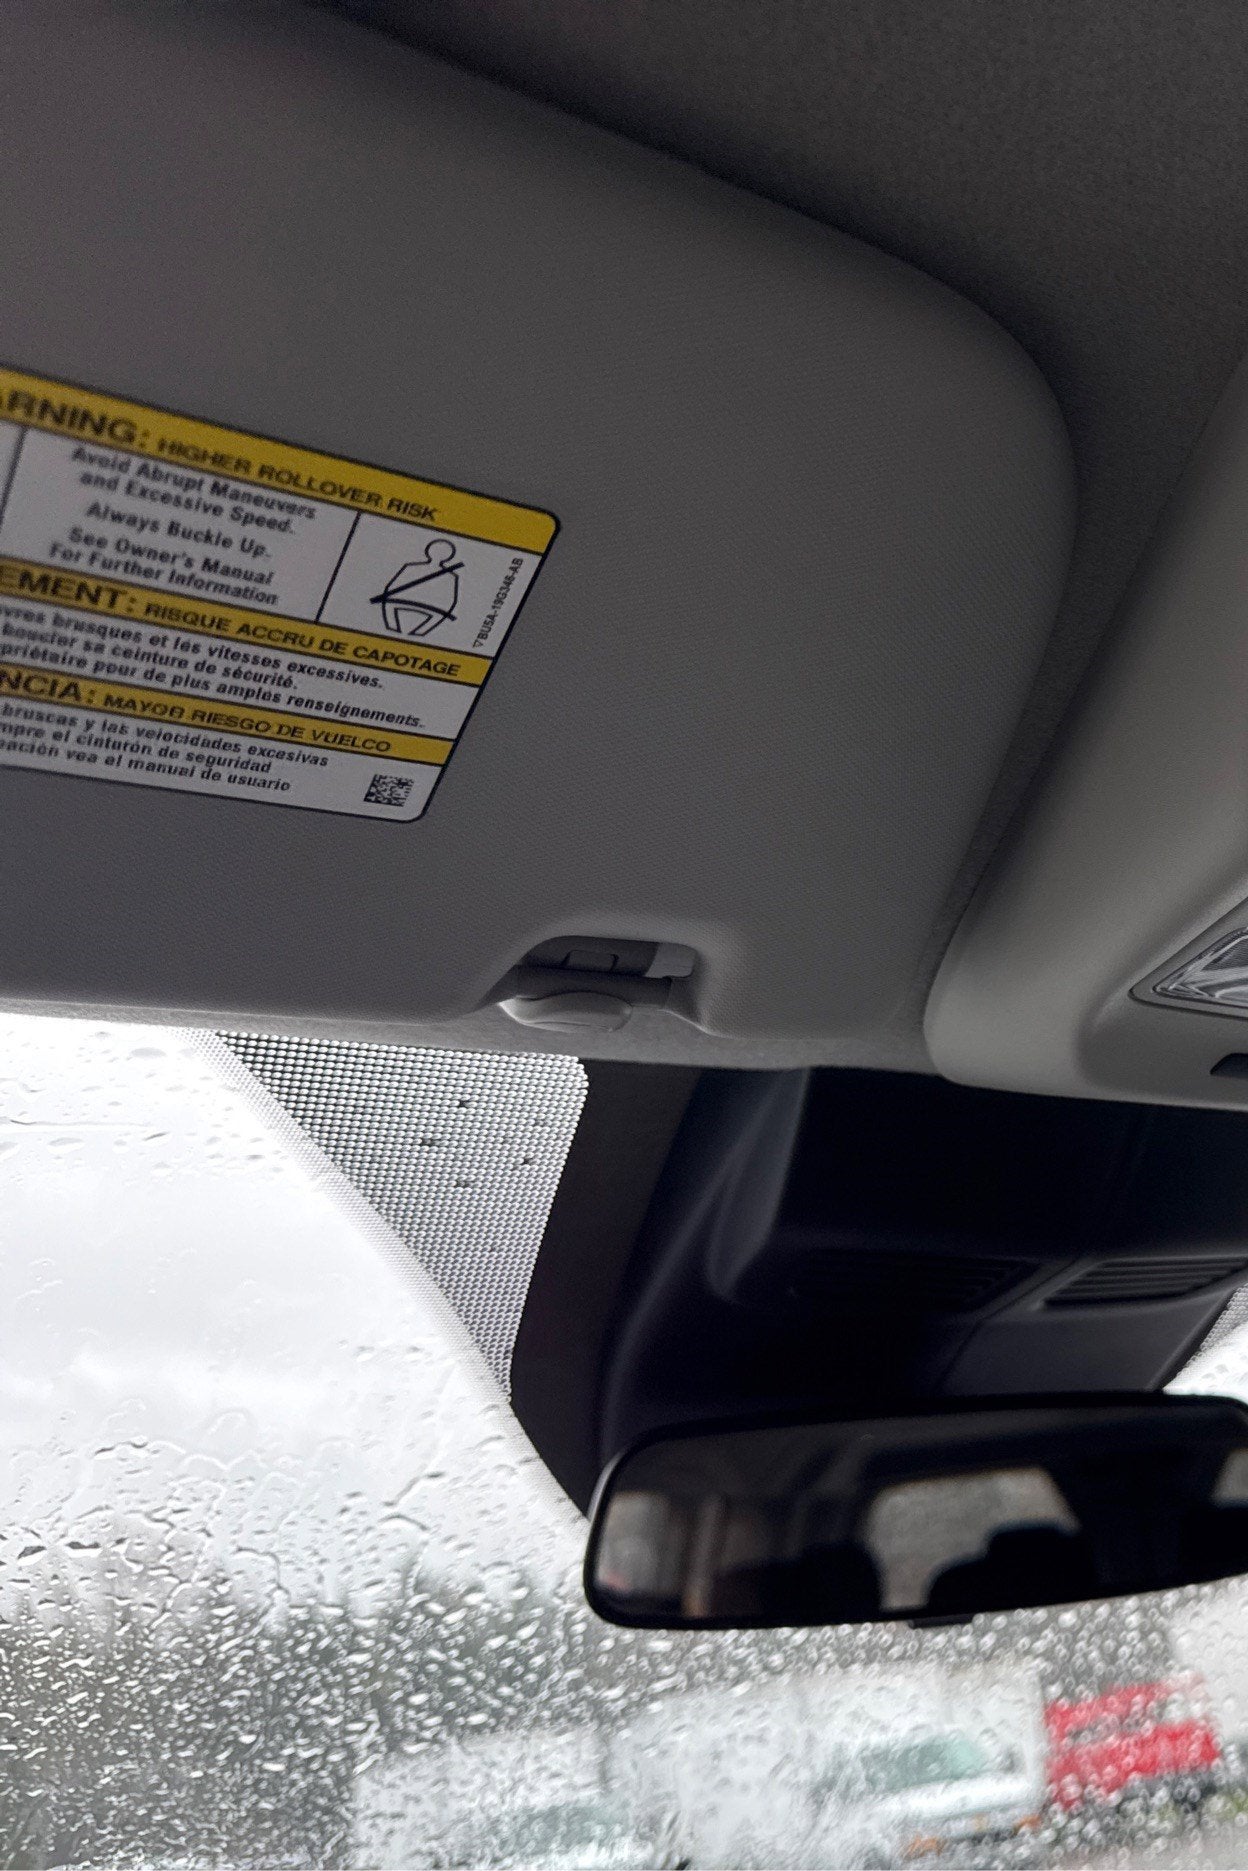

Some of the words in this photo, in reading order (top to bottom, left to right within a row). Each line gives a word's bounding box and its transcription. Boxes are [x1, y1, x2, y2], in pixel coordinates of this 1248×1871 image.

[0, 388, 150, 447] RNING:
[157, 437, 252, 473] HIGHER
[257, 463, 382, 508] ROLLOVER
[387, 497, 440, 521] RISK
[71, 448, 131, 474] Avoid
[136, 462, 204, 492] Abrupt
[210, 480, 316, 520] Maneuvers
[80, 472, 120, 492] and
[125, 478, 224, 517] Excessive
[230, 505, 295, 534] Speed.
[86, 501, 160, 534] Always
[167, 520, 233, 549] Buckle
[240, 537, 272, 559] Up.
[50, 541, 82, 562] For
[88, 550, 163, 580] Further
[168, 568, 280, 605] Information
[68, 525, 108, 549] See
[115, 537, 194, 568] Owner's
[201, 557, 275, 586] Manual
[2, 621, 77, 648] boucler
[112, 644, 189, 669] ceinture
[194, 658, 217, 675] de
[222, 665, 299, 690] sécurité.
[52, 612, 143, 643] brusques
[149, 634, 169, 649] et
[173, 636, 202, 655] les
[208, 643, 282, 670] vitesses
[286, 661, 384, 690] excessives.
[145, 602, 232, 633] RISQUE
[235, 623, 315, 650] ACCRU
[318, 638, 350, 656] DE
[352, 645, 461, 677] CAPOTAGE
[93, 659, 138, 679] pour
[143, 667, 167, 684] de
[171, 673, 211, 692] plus
[216, 682, 282, 705] amples
[287, 693, 425, 729] renseignements.
[104, 694, 185, 718] MAYOR
[191, 708, 272, 733] RIESGO
[276, 723, 307, 739] DE
[312, 728, 391, 753] VUELCO
[2, 703, 78, 727] bruscas
[84, 717, 96, 733] y
[101, 718, 129, 736] las
[136, 726, 242, 754] velocidades
[247, 744, 329, 767] excesivas
[52, 729, 71, 743] el
[76, 733, 153, 757] cinturón
[158, 744, 180, 760] de
[186, 751, 272, 774] seguridad
[66, 749, 99, 764] vea
[104, 753, 123, 767] el
[127, 756, 196, 778] manual
[201, 766, 222, 781] de
[227, 775, 292, 792] usuario
